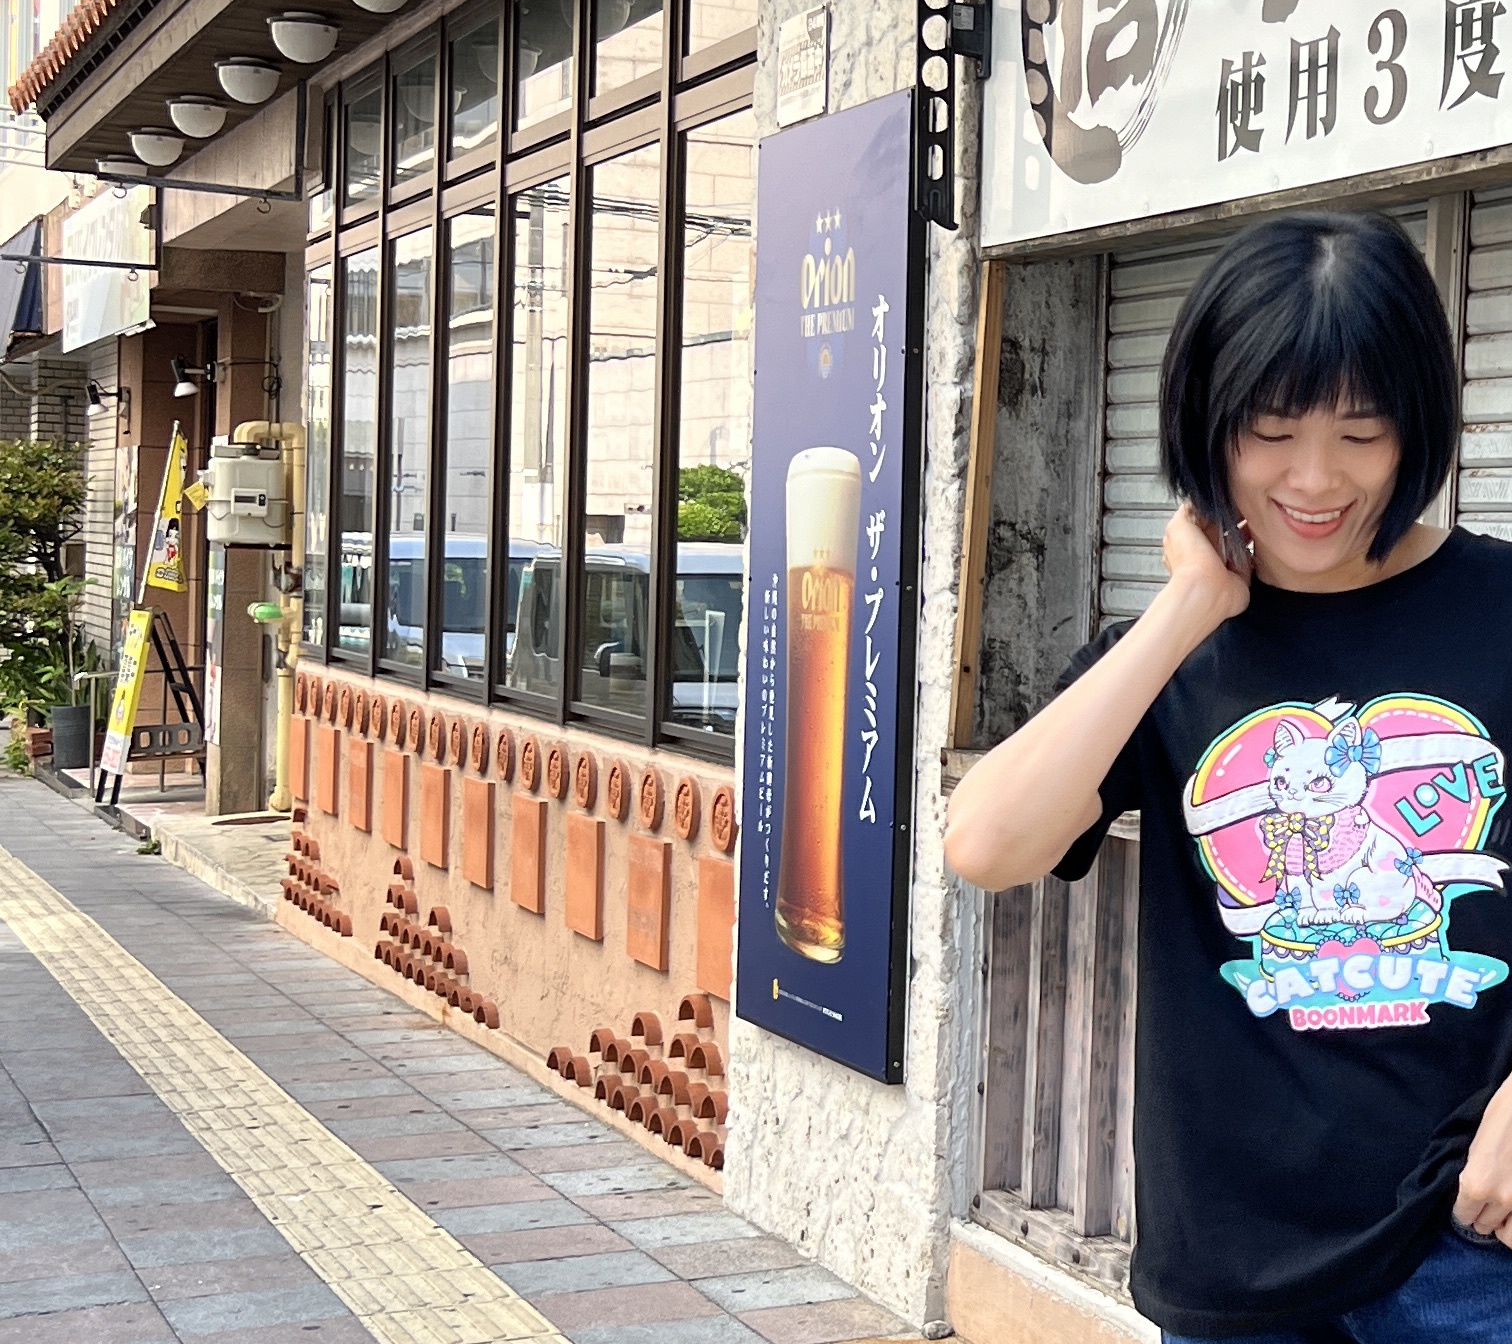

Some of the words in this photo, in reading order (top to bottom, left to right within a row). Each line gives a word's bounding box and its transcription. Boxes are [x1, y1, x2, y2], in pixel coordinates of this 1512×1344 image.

[800, 237, 856, 309] Orion
[800, 313, 816, 338] THE
[869, 294, 890, 483] オリオン
[859, 509, 886, 825] ザ・プレミアム
[1394, 752, 1506, 837] LOVE
[1246, 954, 1482, 1014] CATCUTE
[1291, 1001, 1429, 1028] BOONMARK
